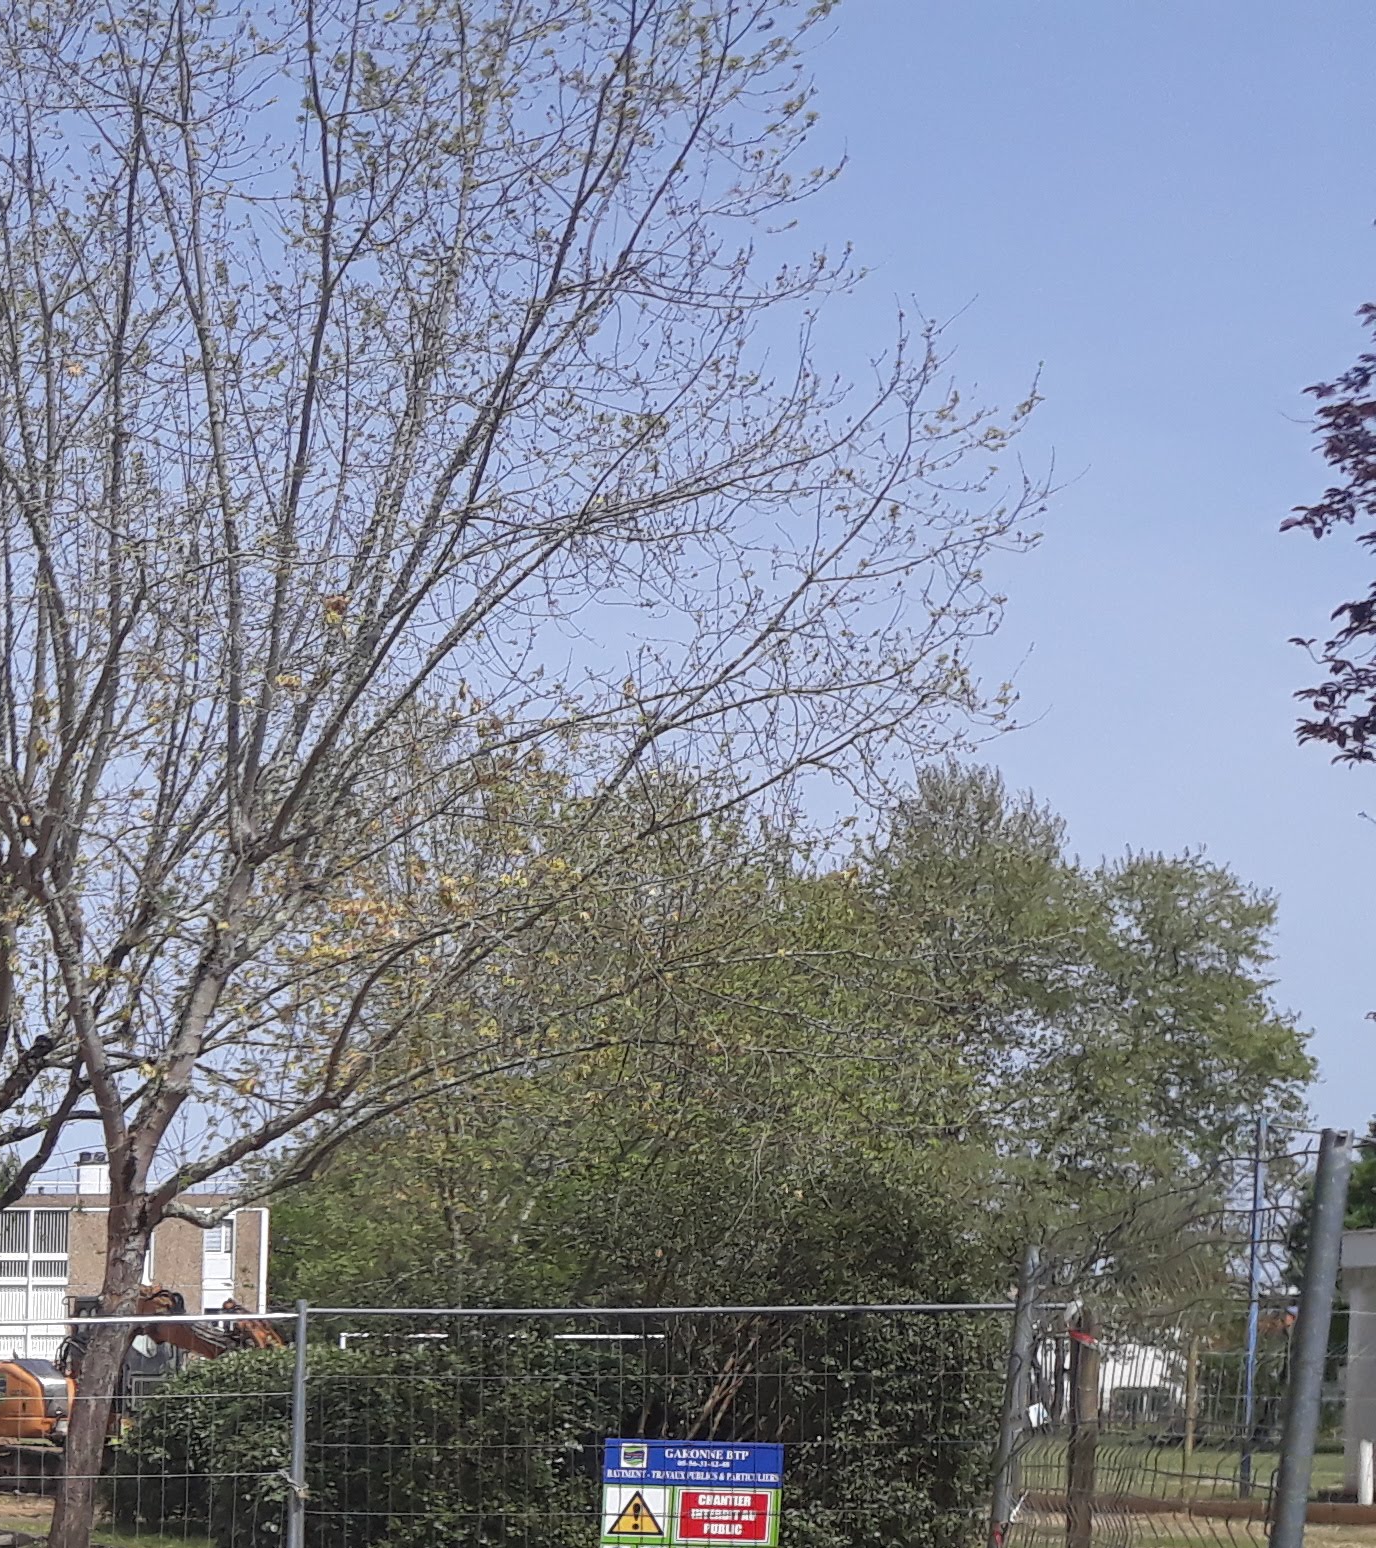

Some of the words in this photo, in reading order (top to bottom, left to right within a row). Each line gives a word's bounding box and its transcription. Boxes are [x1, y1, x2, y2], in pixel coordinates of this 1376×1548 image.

[665, 1448, 724, 1460] GARONNE
[726, 1450, 749, 1461] BTP
[651, 1470, 685, 1480] TRAVAUX
[687, 1471, 718, 1481] PUBLICS
[719, 1472, 725, 1481] &
[726, 1472, 779, 1482] PARTICULIERS
[698, 1494, 751, 1507] CHANTIER
[691, 1508, 740, 1521] INTERDIT
[741, 1510, 757, 1522] AU
[703, 1522, 743, 1535] PUBLIC
